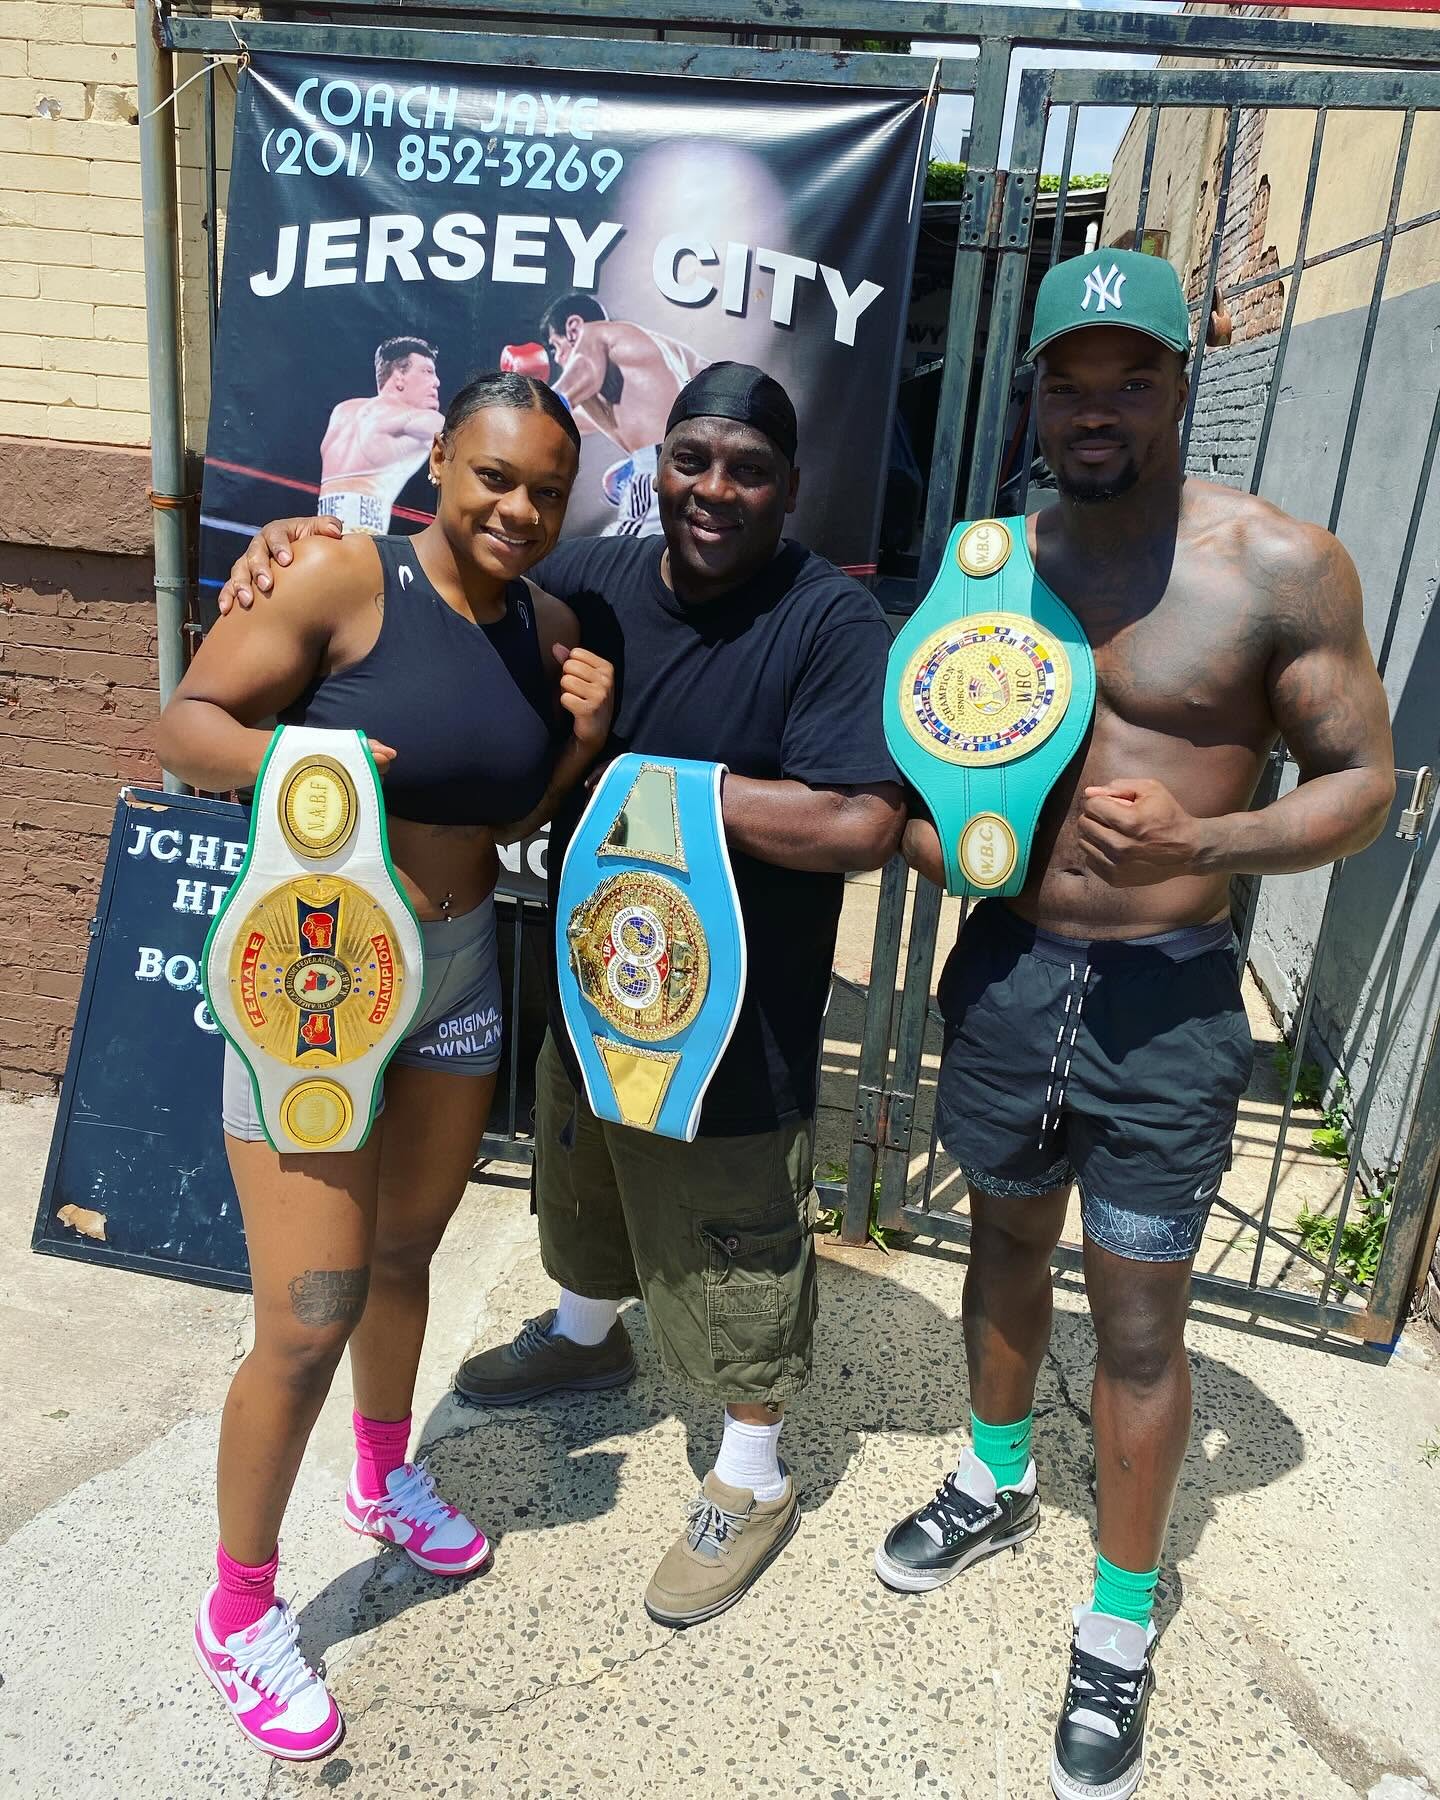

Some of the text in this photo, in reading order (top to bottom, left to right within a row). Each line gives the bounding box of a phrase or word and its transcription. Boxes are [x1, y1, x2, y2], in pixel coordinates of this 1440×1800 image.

[295, 77, 600, 141] COACH JAYE
[261, 128, 624, 194] (201) 852-3269
[249, 214, 885, 347] JERSEY CITY
[1081, 263, 1127, 312] NY
[938, 665, 956, 722] CHAMPION
[1015, 668, 1032, 702] WBC
[134, 946, 205, 994] BO
[603, 939, 613, 958] IBF
[243, 936, 264, 1024] FEMALE
[372, 936, 392, 1022] CHAMPION
